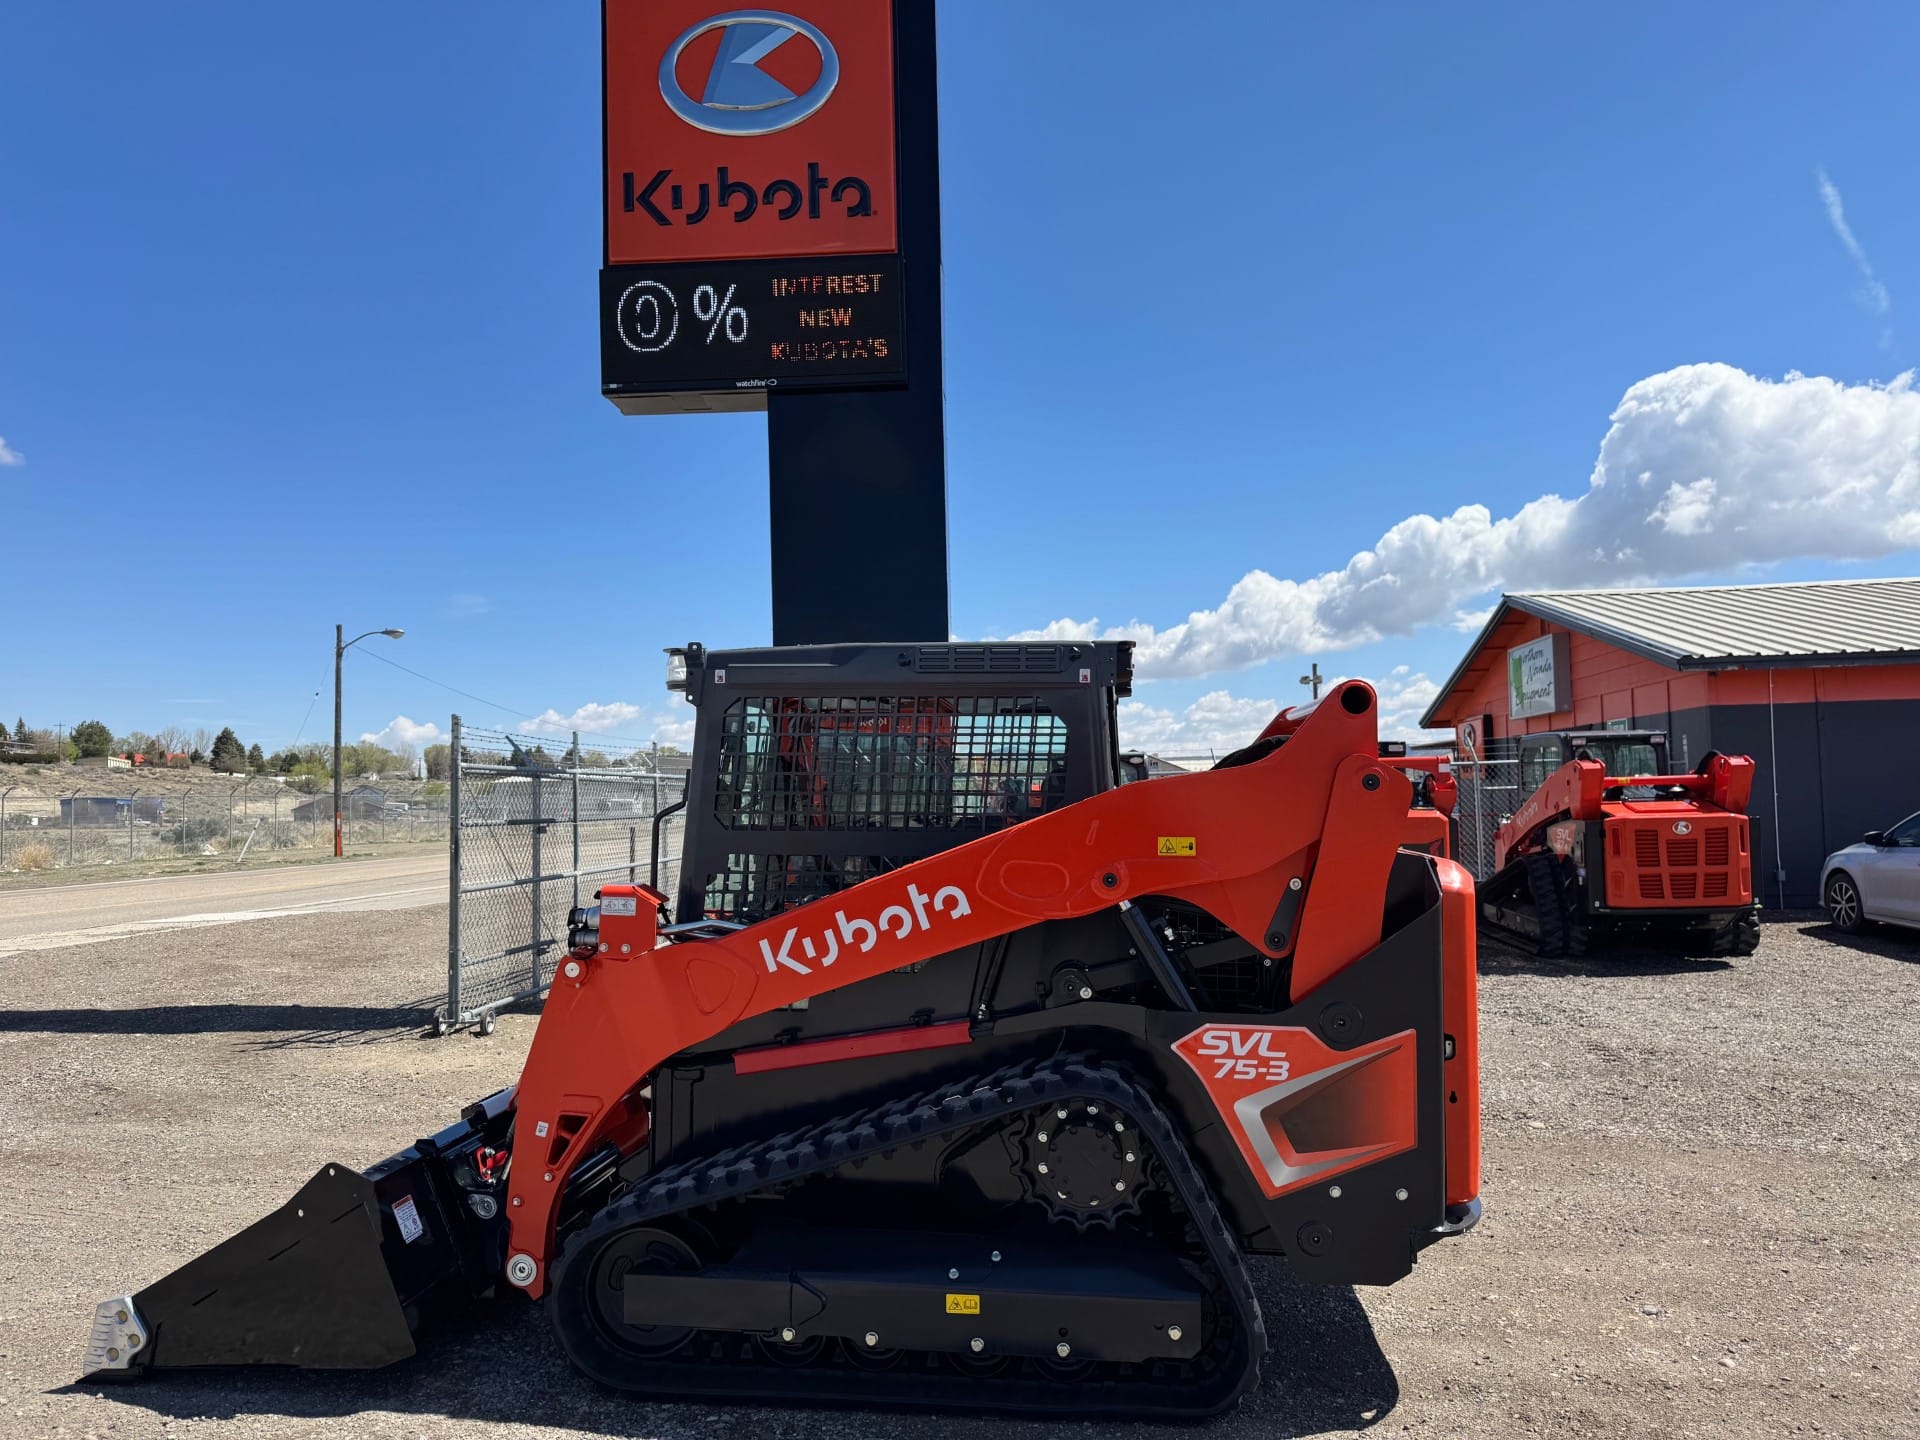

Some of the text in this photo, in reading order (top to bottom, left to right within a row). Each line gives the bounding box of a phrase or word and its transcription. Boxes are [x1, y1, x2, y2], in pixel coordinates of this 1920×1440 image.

[622, 162, 872, 226] Kubota
[799, 308, 852, 328] NEW
[1556, 829, 1571, 840] SVL
[759, 883, 972, 975] Kubota
[1197, 1030, 1287, 1057] SVL
[1214, 1059, 1290, 1080] 75-3
